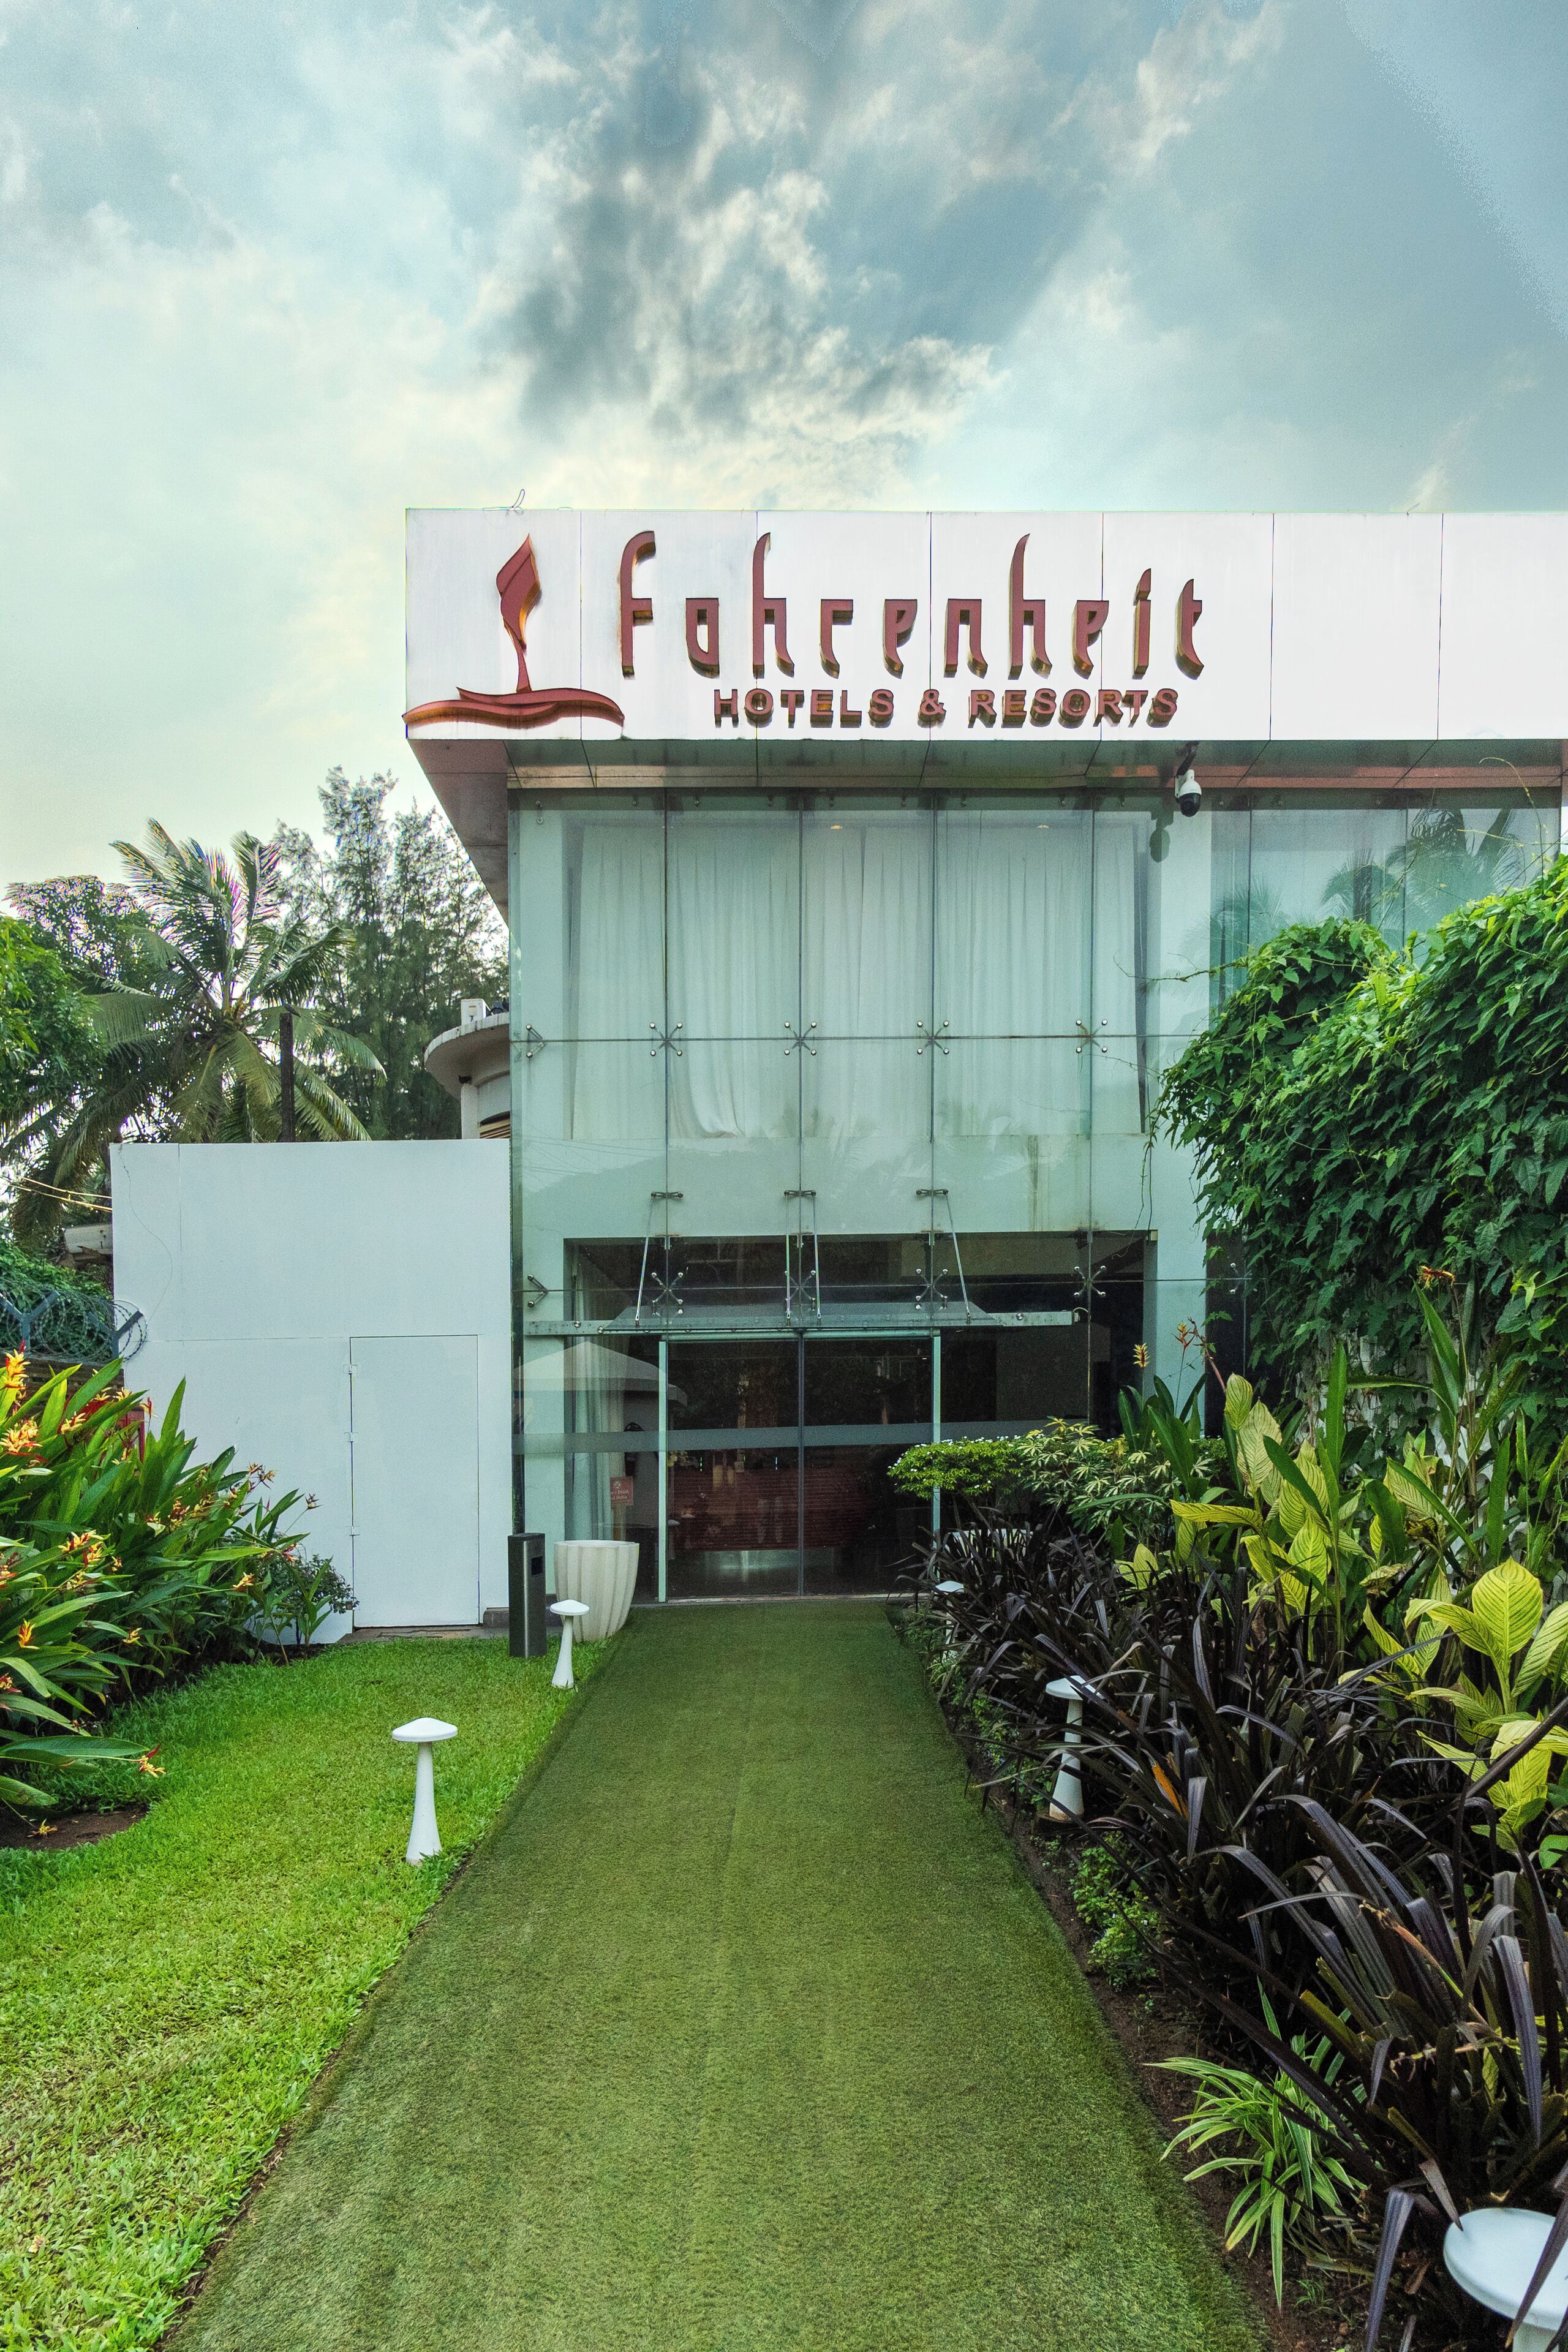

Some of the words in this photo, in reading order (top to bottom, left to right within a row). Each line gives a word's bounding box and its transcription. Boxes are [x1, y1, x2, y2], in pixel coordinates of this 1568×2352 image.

[620, 530, 1204, 678] fahrenheit
[714, 688, 894, 727] HOTELS
[918, 688, 946, 727] &
[968, 688, 1178, 727] RESORTS
